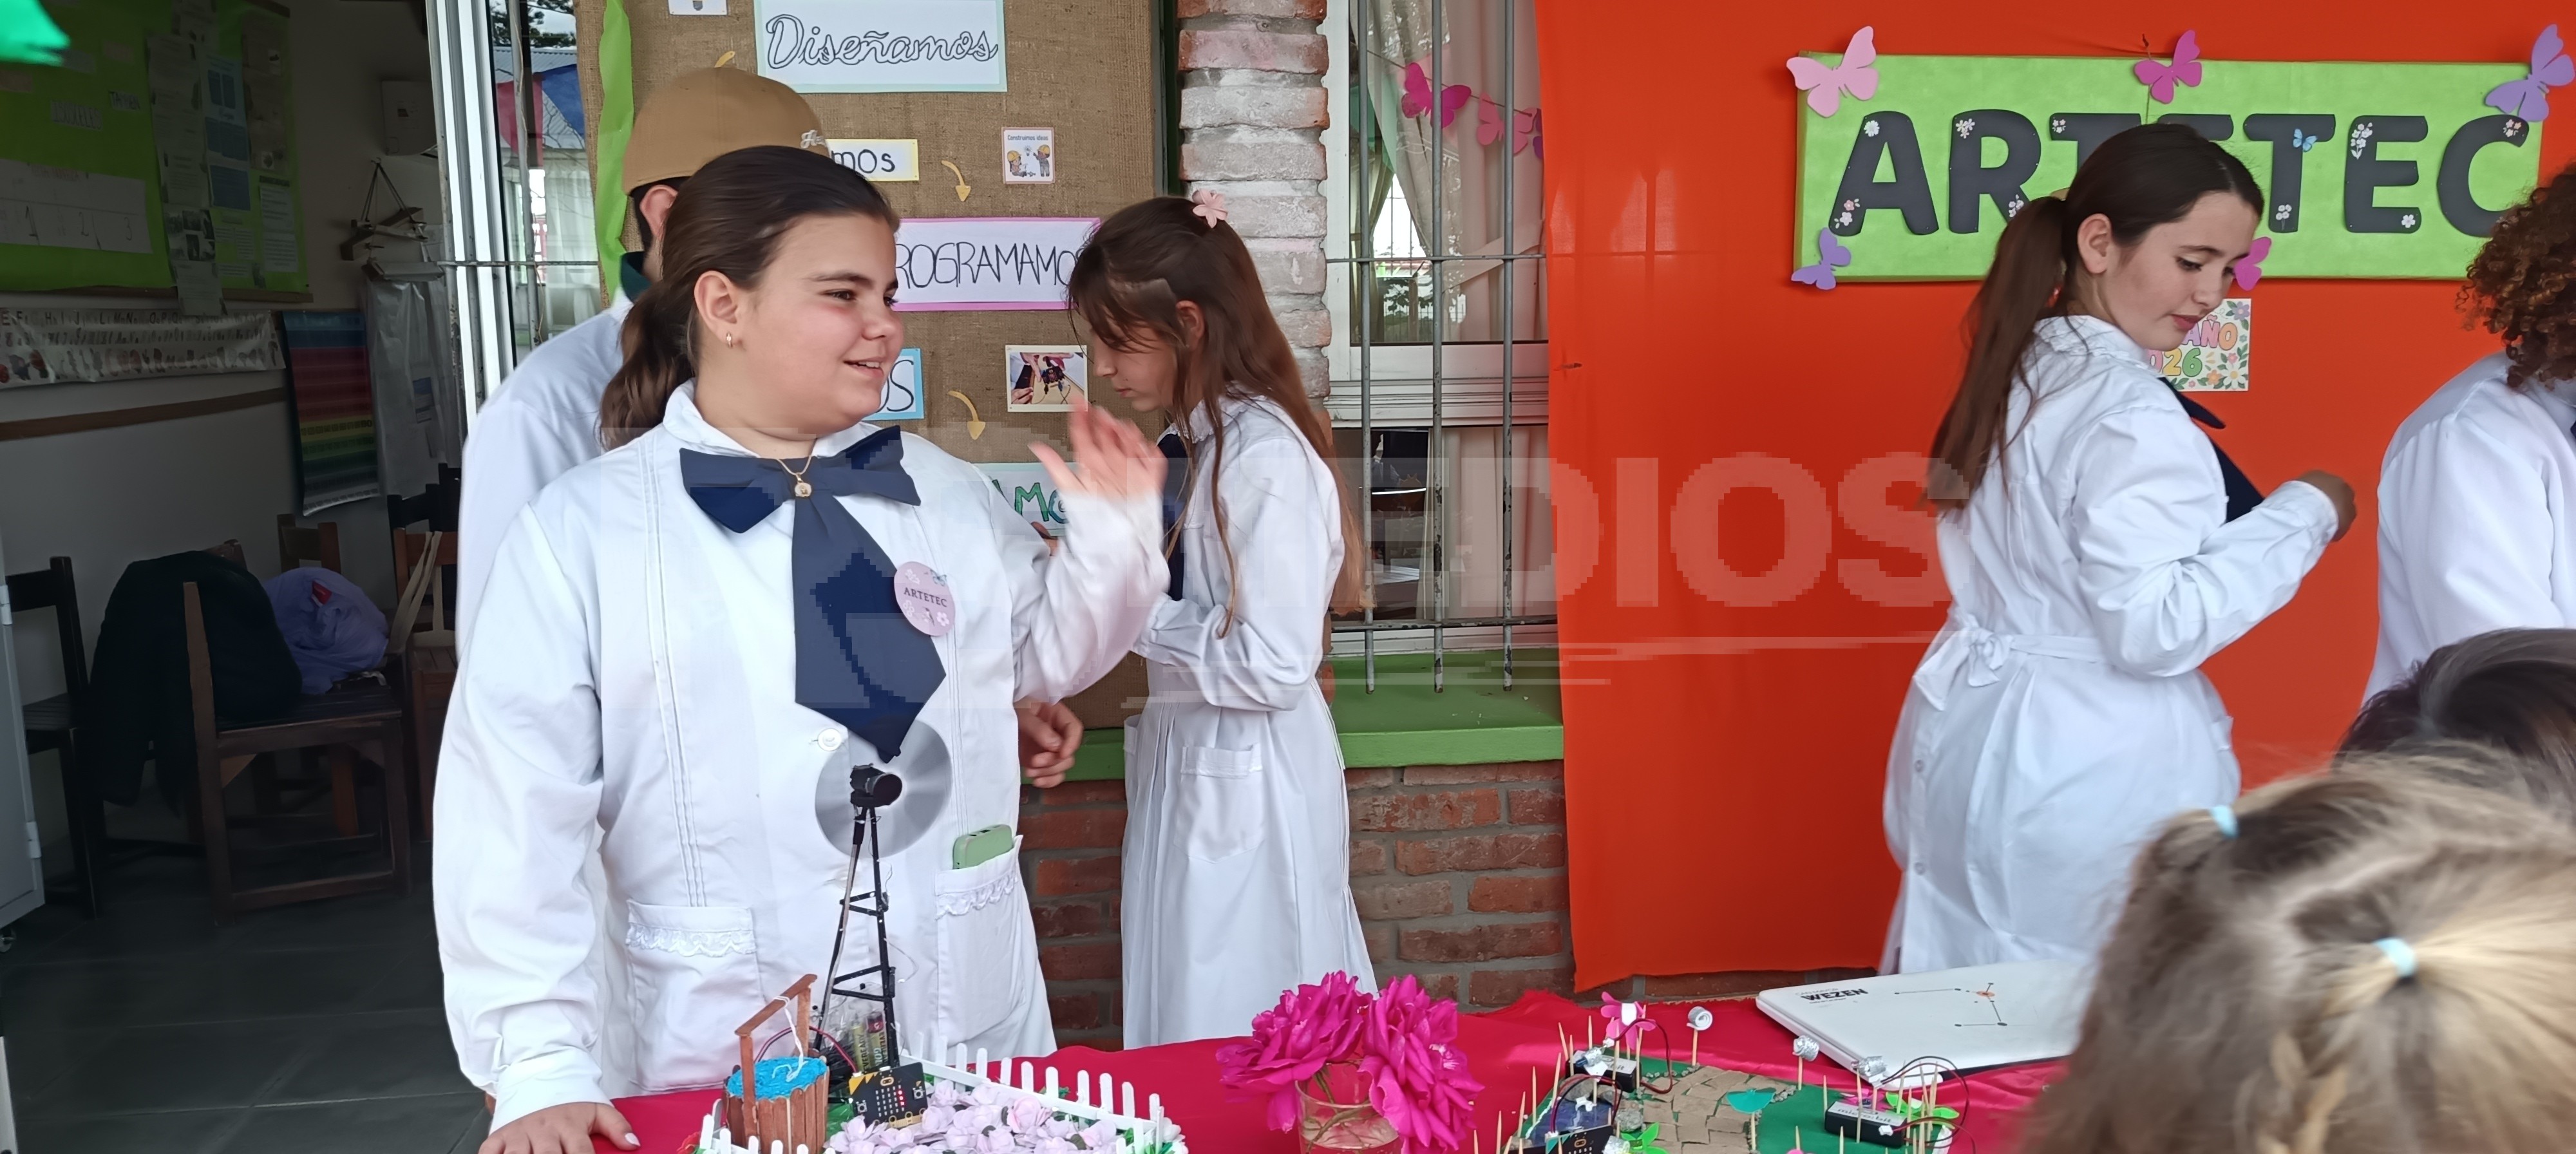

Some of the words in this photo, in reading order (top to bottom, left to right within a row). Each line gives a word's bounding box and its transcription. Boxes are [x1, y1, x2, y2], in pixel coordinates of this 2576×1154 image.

[766, 14, 999, 69] Diseñamos
[1828, 108, 2530, 238] ARTTEC
[896, 241, 1084, 288] ROGRAMAMO
[904, 587, 948, 607] ARTETEC
[1801, 988, 1868, 1001] WEZEN
[1837, 1108, 1892, 1123] mico:bit
